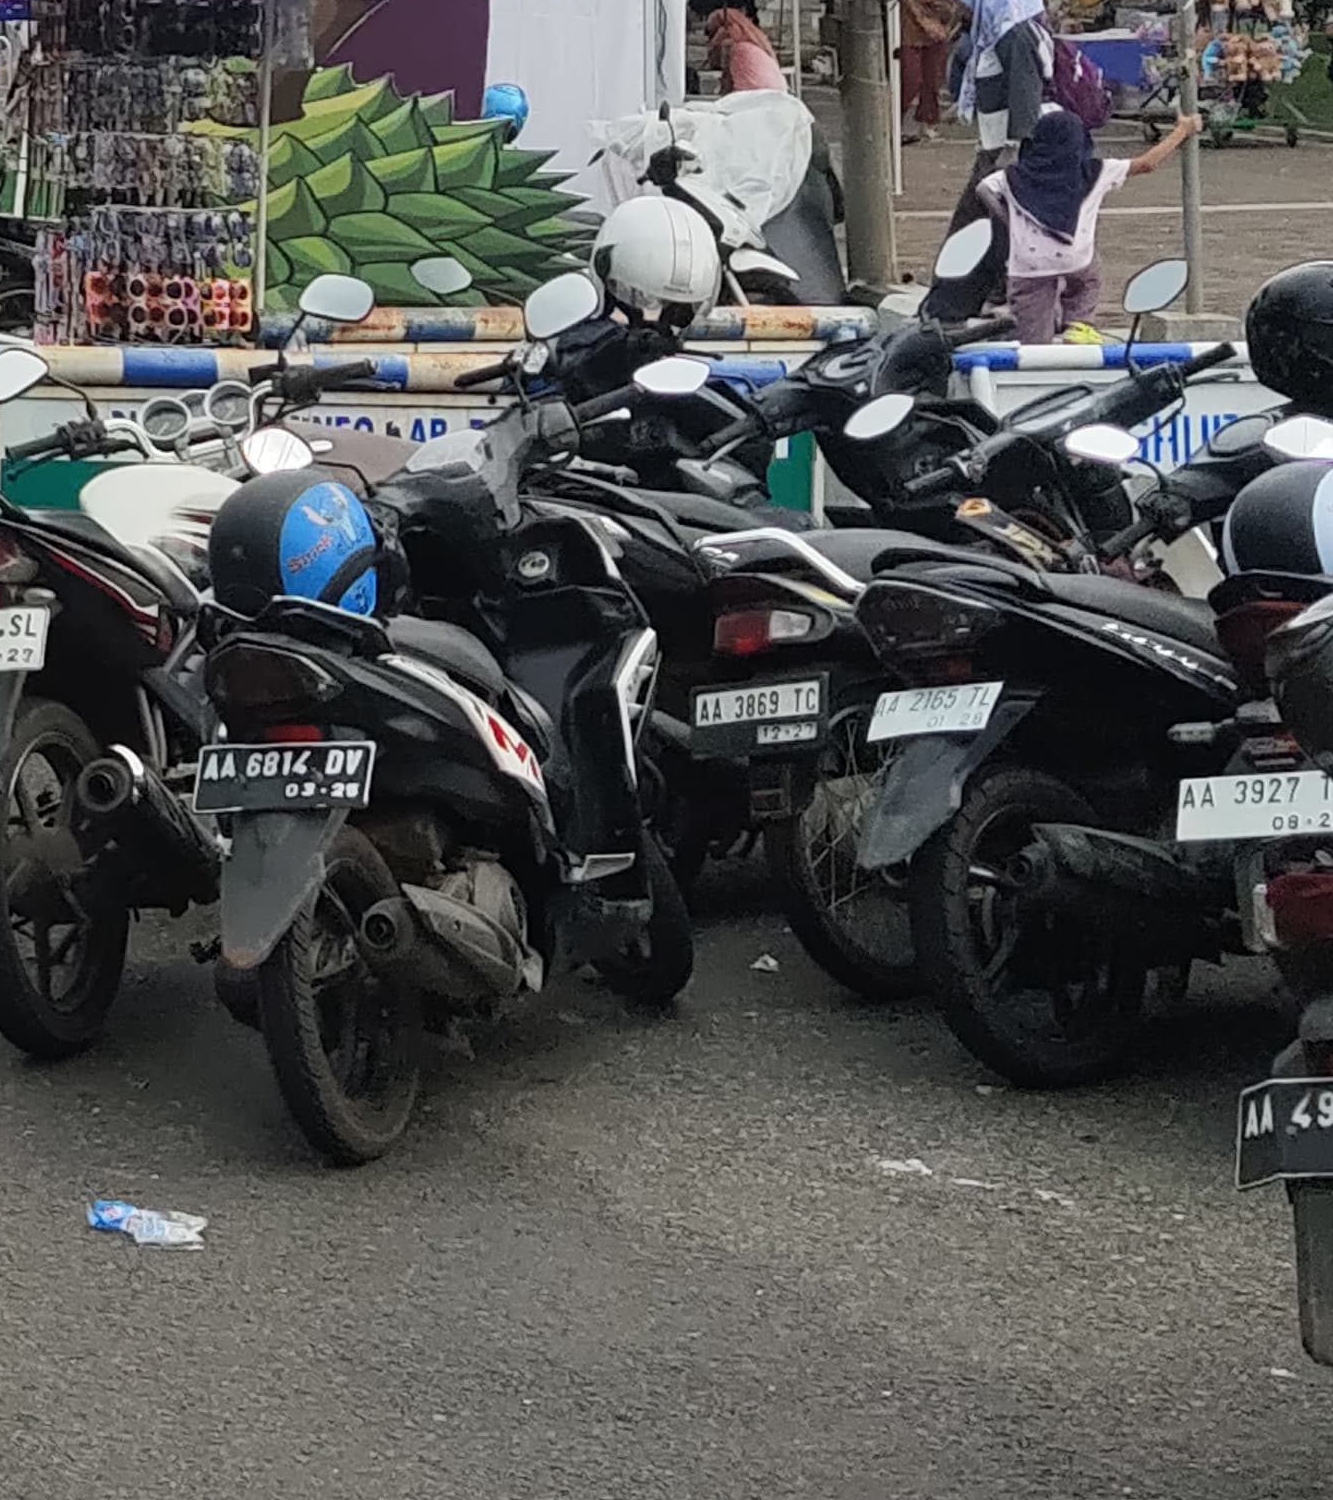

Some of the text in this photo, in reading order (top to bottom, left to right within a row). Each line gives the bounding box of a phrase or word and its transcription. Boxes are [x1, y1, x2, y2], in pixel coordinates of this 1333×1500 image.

[700, 687, 817, 722] AA 3869 TC
[876, 686, 990, 716] AA 2165 TL
[203, 748, 364, 781] AA 6814 DV
[1182, 774, 1333, 809] AA 3927 T
[1244, 1090, 1333, 1139] AA 49
